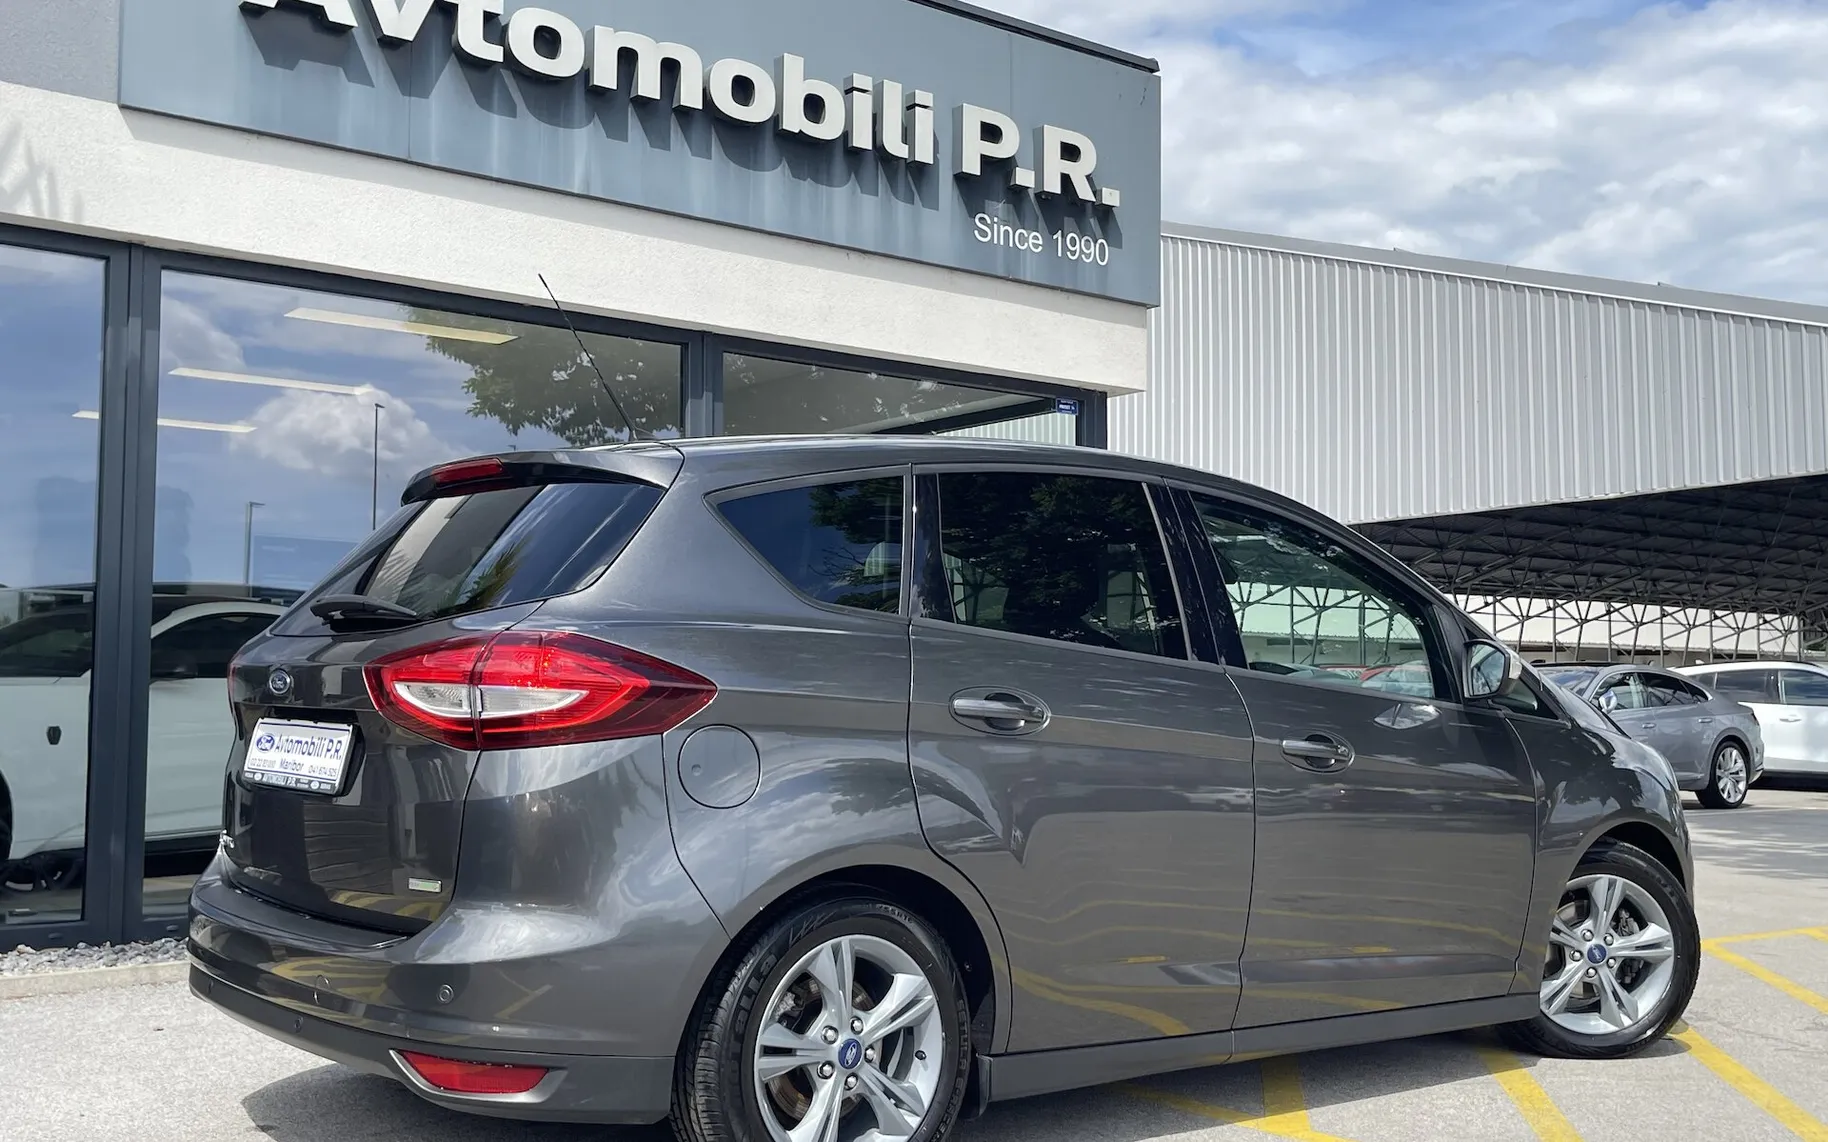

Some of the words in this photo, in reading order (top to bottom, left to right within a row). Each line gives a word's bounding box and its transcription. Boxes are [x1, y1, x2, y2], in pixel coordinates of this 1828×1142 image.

[238, 0, 934, 165] vtomobili
[952, 102, 1121, 207] P.R.
[973, 212, 1044, 253] Since
[1052, 229, 1109, 266] 1990
[275, 734, 327, 758] Avtomobili
[325, 738, 343, 760] P.R.
[280, 757, 304, 772] Maribor
